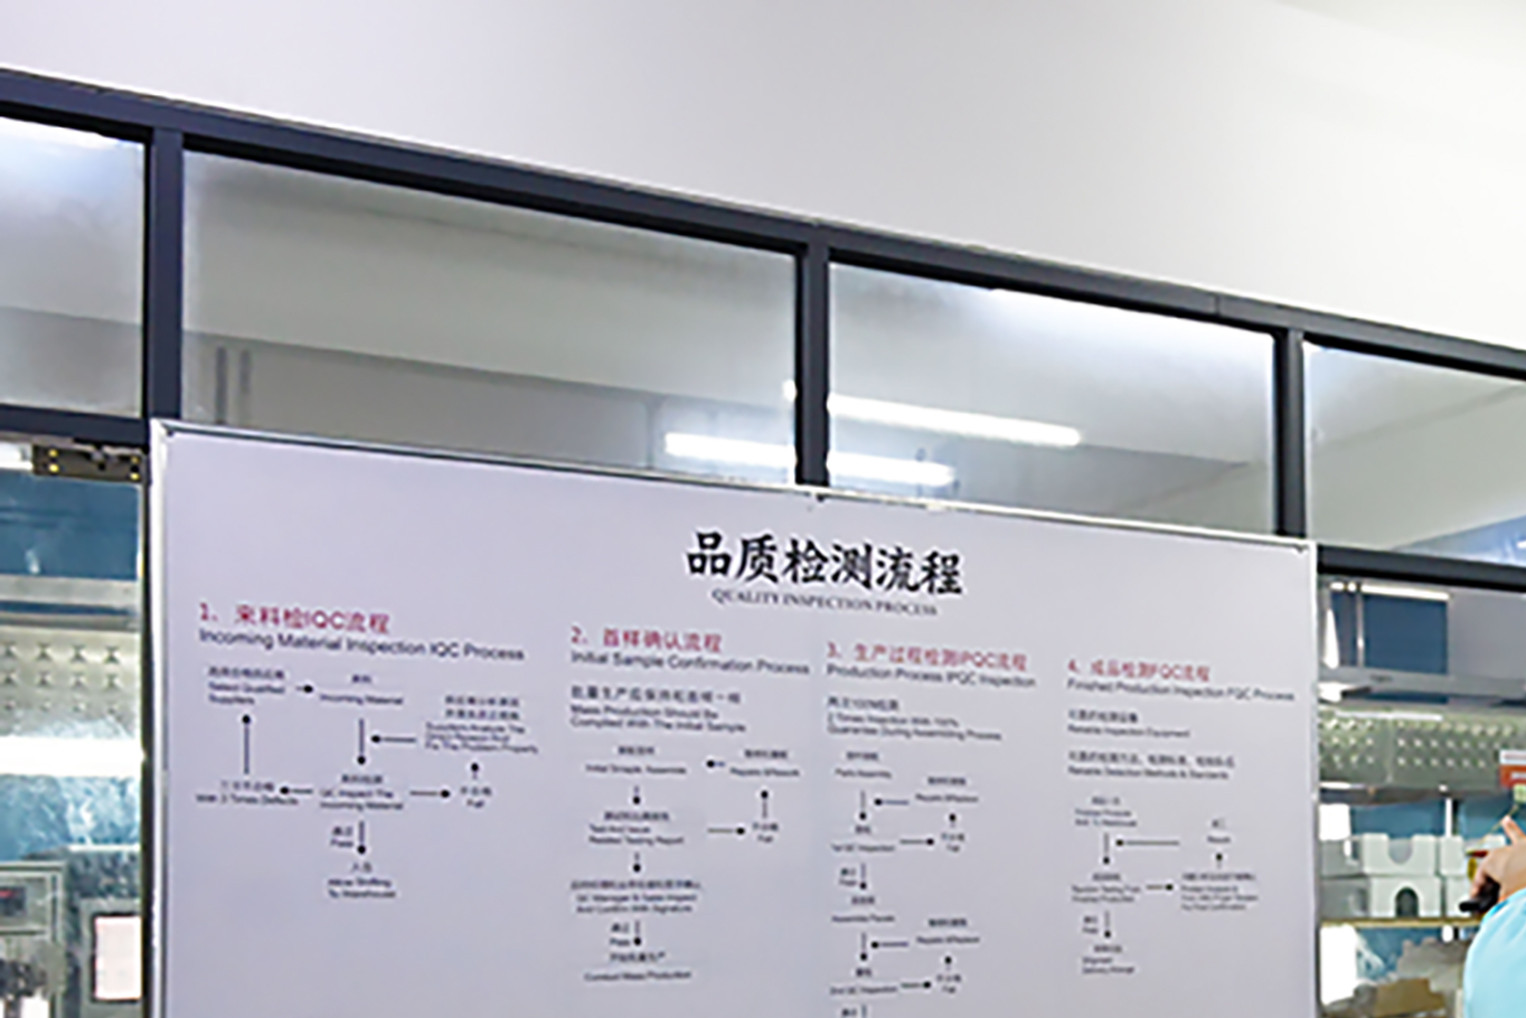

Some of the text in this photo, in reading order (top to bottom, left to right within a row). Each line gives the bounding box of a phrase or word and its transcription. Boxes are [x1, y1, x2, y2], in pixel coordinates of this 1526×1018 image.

[687, 531, 962, 595] 品质检测流程
[712, 589, 938, 616] QUALITY INSPECTION PROCESS
[199, 628, 525, 661] Incoming Material Inspection IQC Process
[571, 650, 810, 675] Initial Sample Confirmation Process
[827, 663, 892, 678] Production
[896, 668, 943, 682] Process
[980, 673, 1036, 688] Inspection
[1068, 678, 1113, 693] Finished
[1116, 681, 1171, 695] Production
[1174, 685, 1224, 698] Inspection
[1253, 689, 1296, 702] Process
